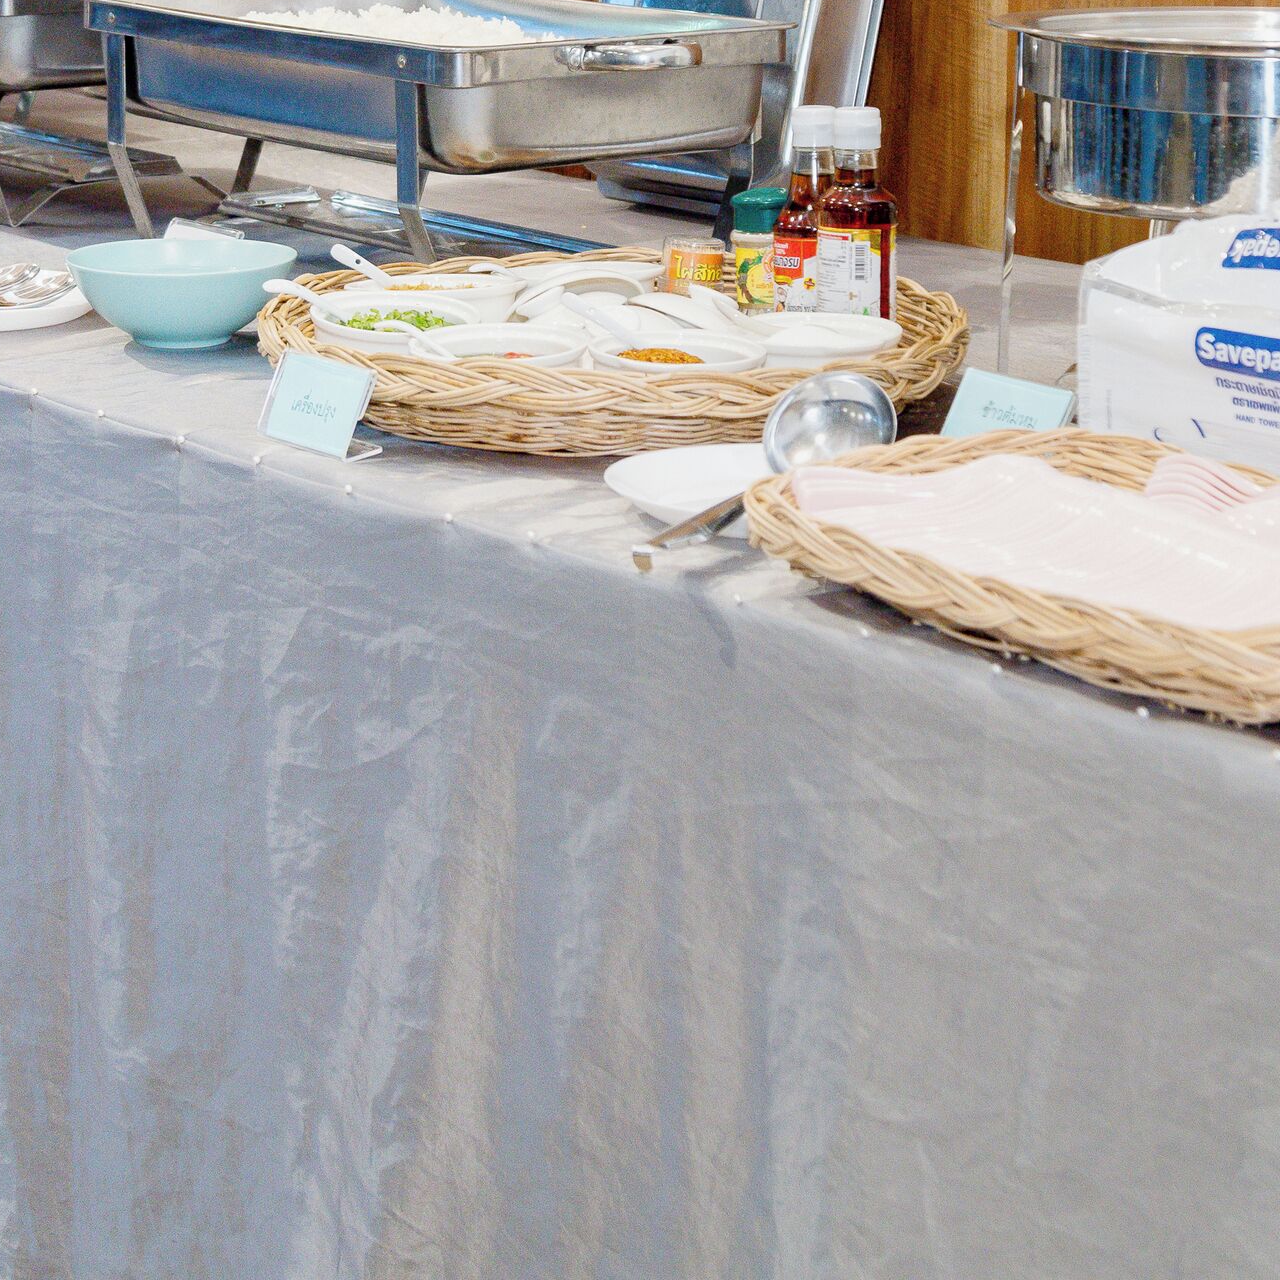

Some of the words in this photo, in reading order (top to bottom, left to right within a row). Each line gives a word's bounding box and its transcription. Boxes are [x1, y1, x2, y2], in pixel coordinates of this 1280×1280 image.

[290, 388, 336, 422] เครื่องปรุง
[1235, 414, 1256, 424] HAND
